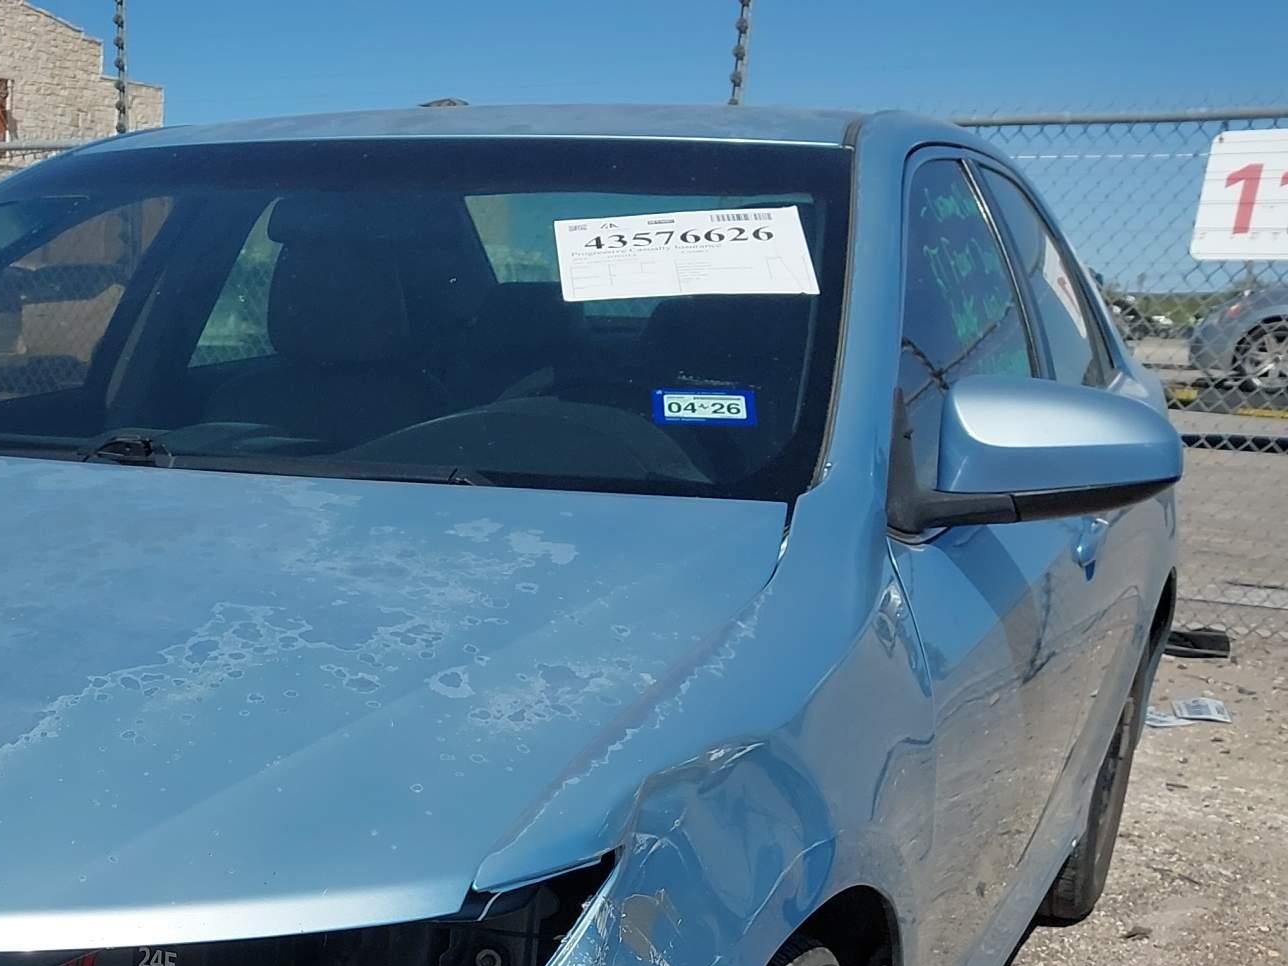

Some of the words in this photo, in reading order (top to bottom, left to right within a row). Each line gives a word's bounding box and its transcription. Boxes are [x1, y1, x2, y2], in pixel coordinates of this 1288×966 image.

[1223, 162, 1288, 235] 1
[583, 225, 775, 251] 43576626
[667, 401, 697, 414] 04
[711, 402, 742, 415] 26
